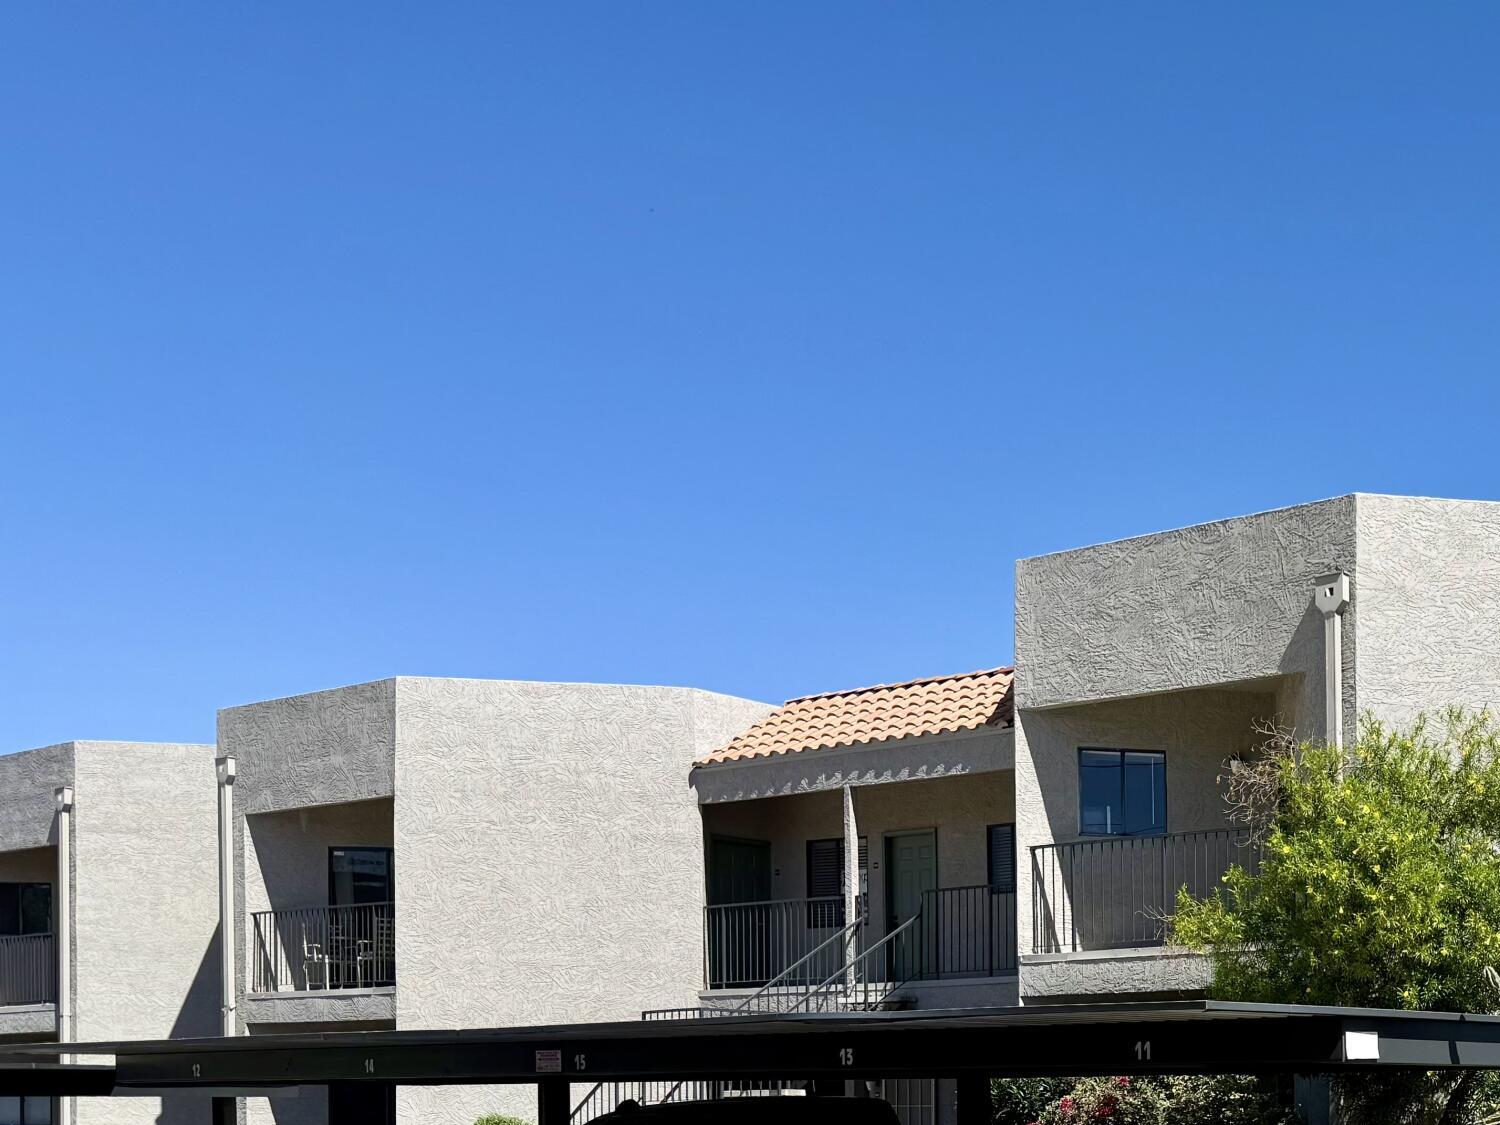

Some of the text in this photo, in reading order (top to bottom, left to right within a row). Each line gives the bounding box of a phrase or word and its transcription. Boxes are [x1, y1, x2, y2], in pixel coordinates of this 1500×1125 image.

[840, 1048, 853, 1065] 13
[1135, 1041, 1150, 1060] 11
[575, 1054, 586, 1070] 15
